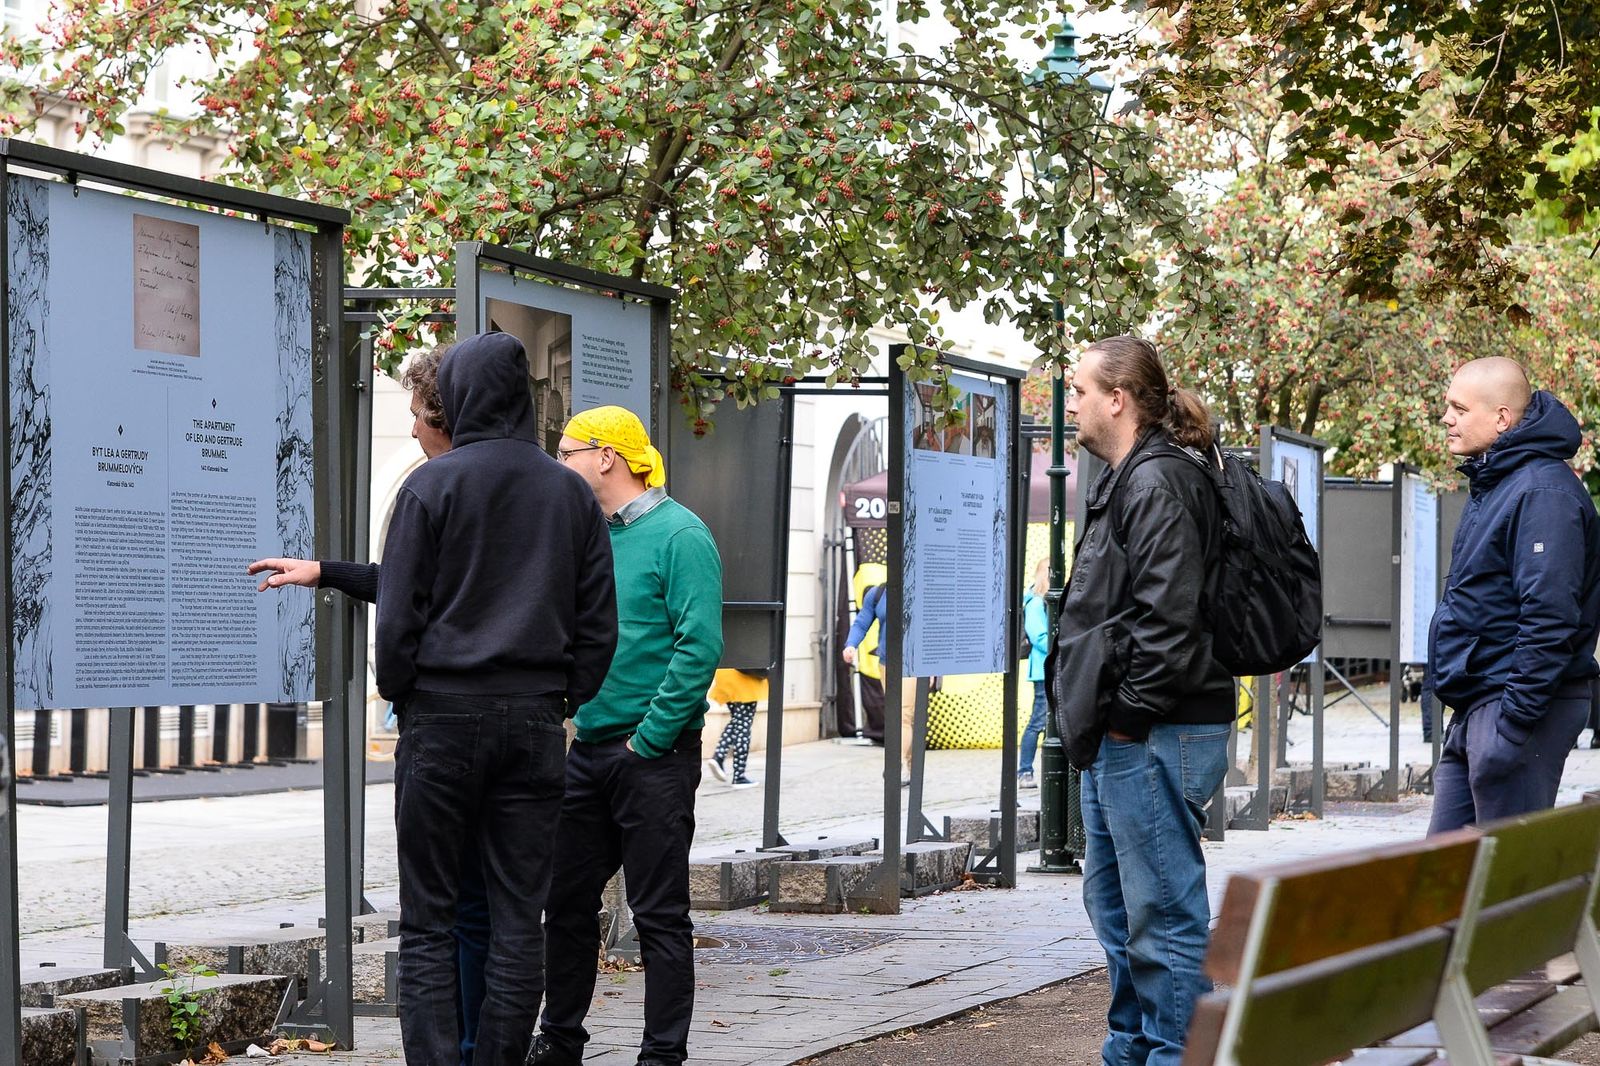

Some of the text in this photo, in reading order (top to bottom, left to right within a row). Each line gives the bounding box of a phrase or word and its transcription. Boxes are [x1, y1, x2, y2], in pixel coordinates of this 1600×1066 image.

[193, 418, 236, 432] THE APARTMENT
[185, 432, 243, 447] OF LEO AND GERTRUDE
[92, 446, 149, 461] BYT LEA A GERTRUDY
[201, 448, 227, 459] BRUMMEL
[97, 461, 144, 475] BRUMMELOVÝCH
[854, 497, 886, 519] 20
